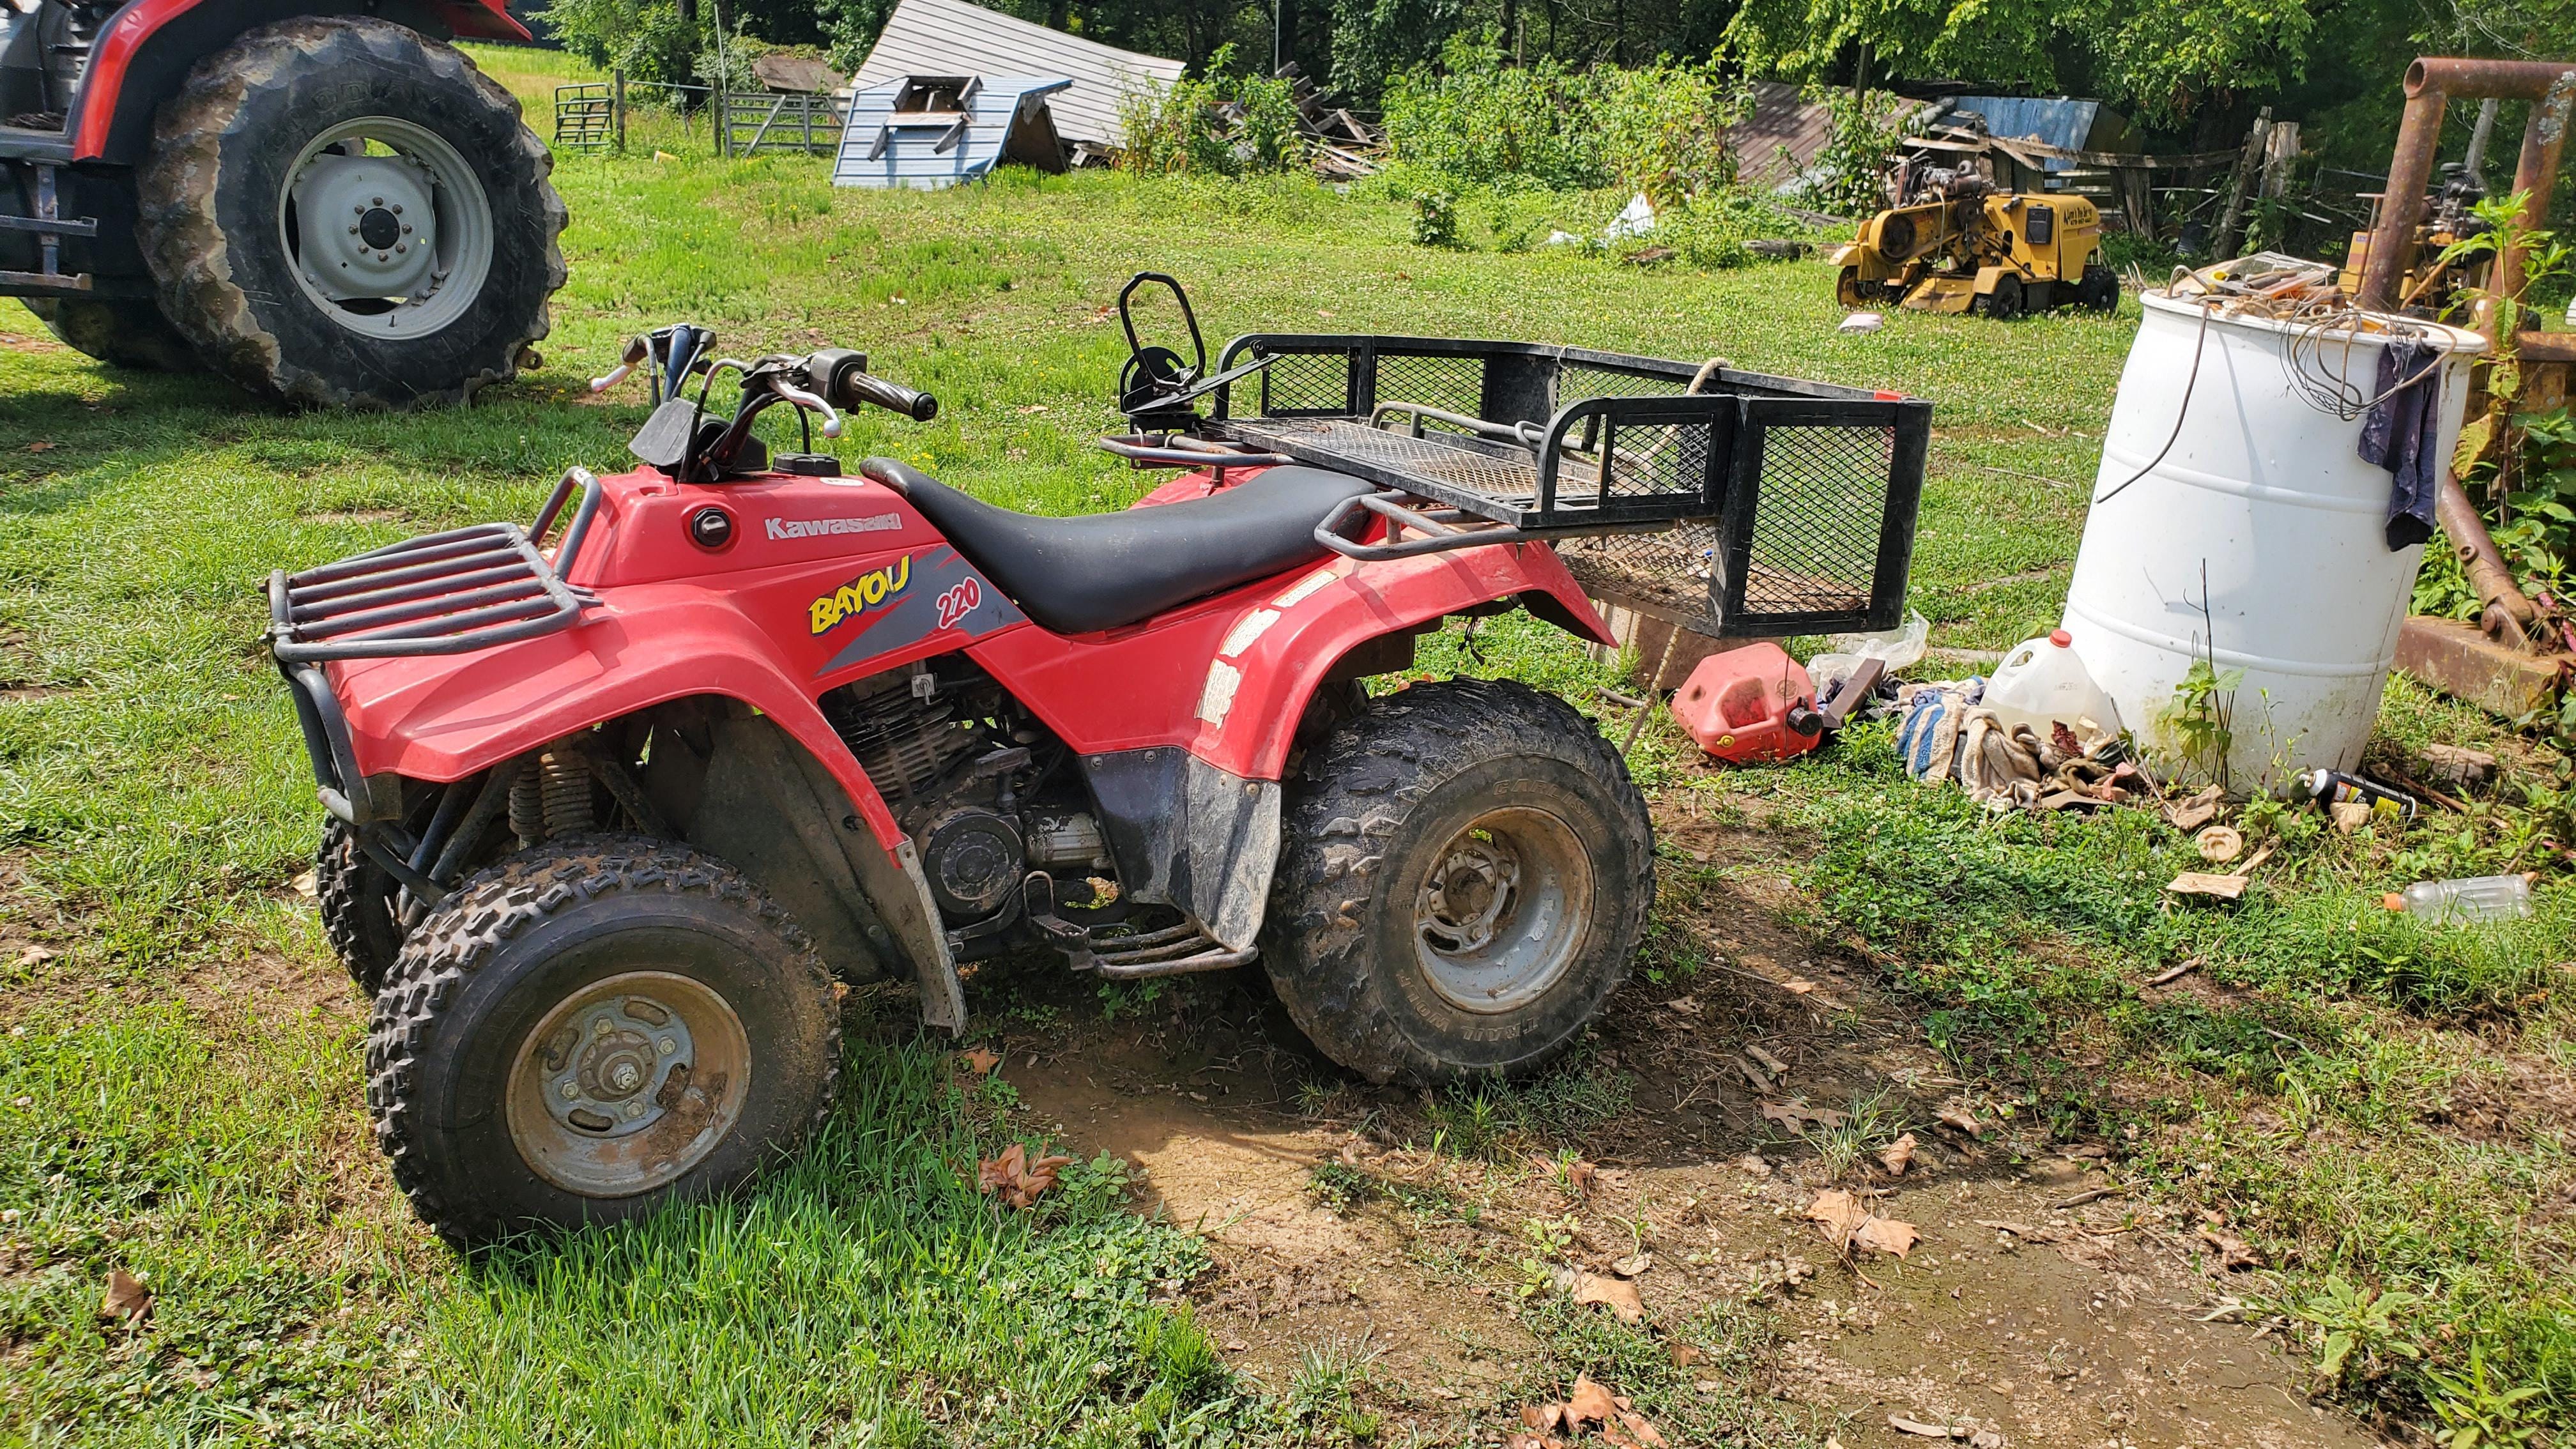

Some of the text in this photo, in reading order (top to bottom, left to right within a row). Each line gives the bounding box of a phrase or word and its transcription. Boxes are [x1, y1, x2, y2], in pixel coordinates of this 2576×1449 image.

[764, 512, 902, 540] Kawasaki
[808, 554, 912, 636] BAYOU
[936, 576, 982, 630] 220
[1395, 972, 1538, 1042] TRAIL WOLF
